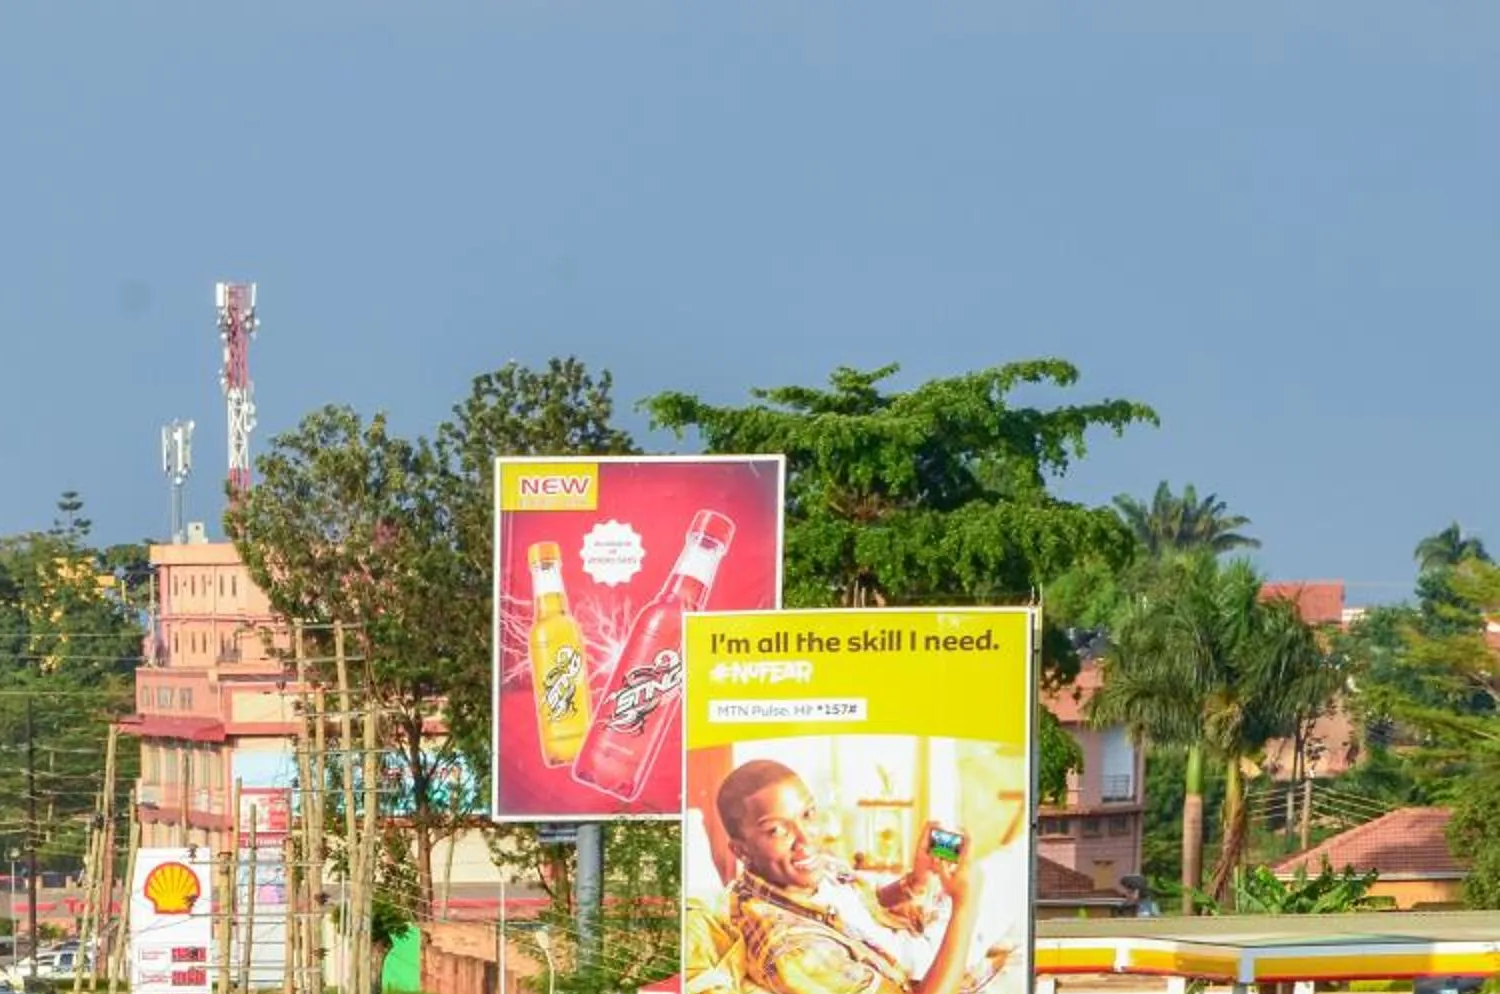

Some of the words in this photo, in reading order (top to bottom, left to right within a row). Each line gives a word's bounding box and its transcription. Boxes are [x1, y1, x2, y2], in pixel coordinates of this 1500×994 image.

[520, 476, 590, 495] NEW
[711, 633, 750, 654] I'm
[757, 631, 789, 653] all
[796, 631, 841, 653] the
[847, 630, 902, 653] skill
[910, 630, 916, 651] I
[924, 629, 1000, 651] need.
